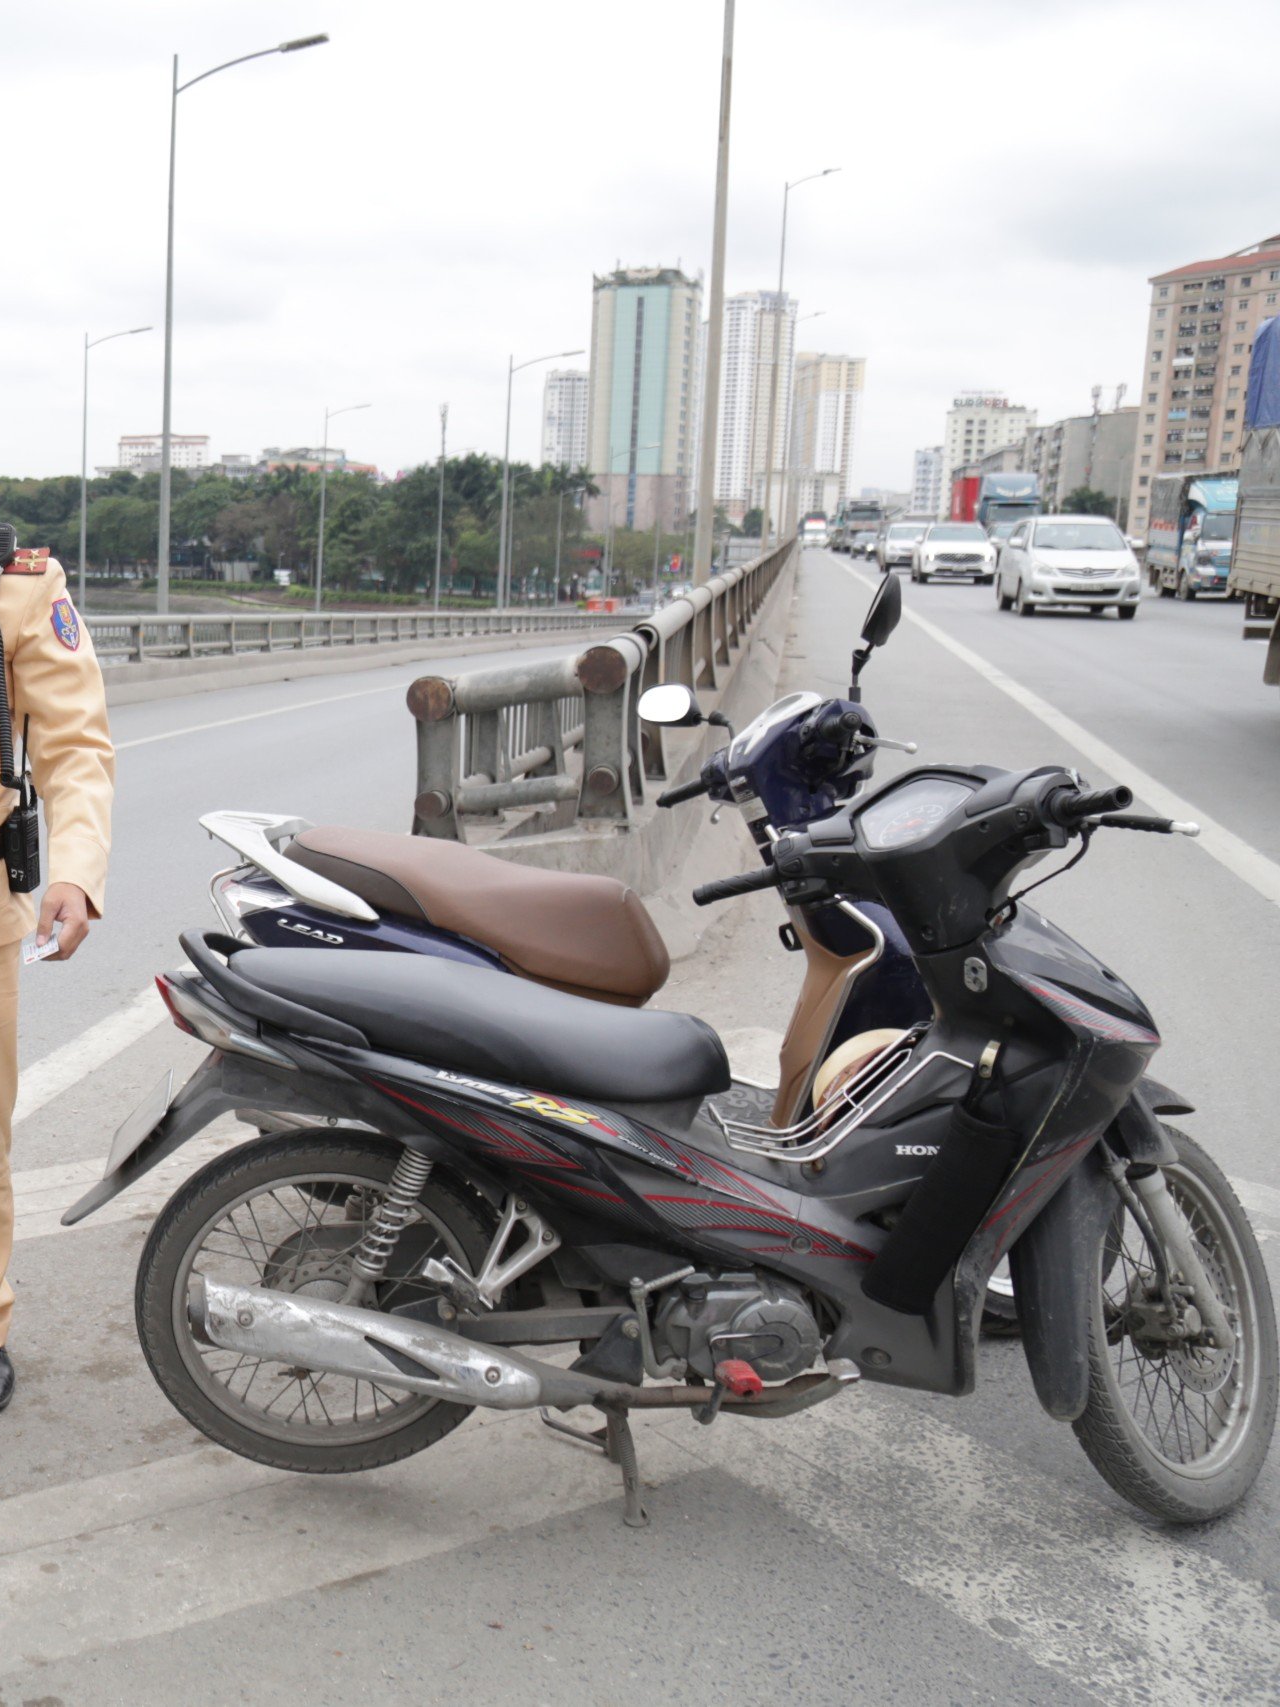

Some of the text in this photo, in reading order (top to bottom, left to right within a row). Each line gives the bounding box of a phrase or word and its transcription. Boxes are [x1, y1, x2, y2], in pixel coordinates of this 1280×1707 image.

[277, 918, 344, 944] LEAD
[509, 1094, 600, 1125] RS
[895, 1145, 940, 1155] HON
